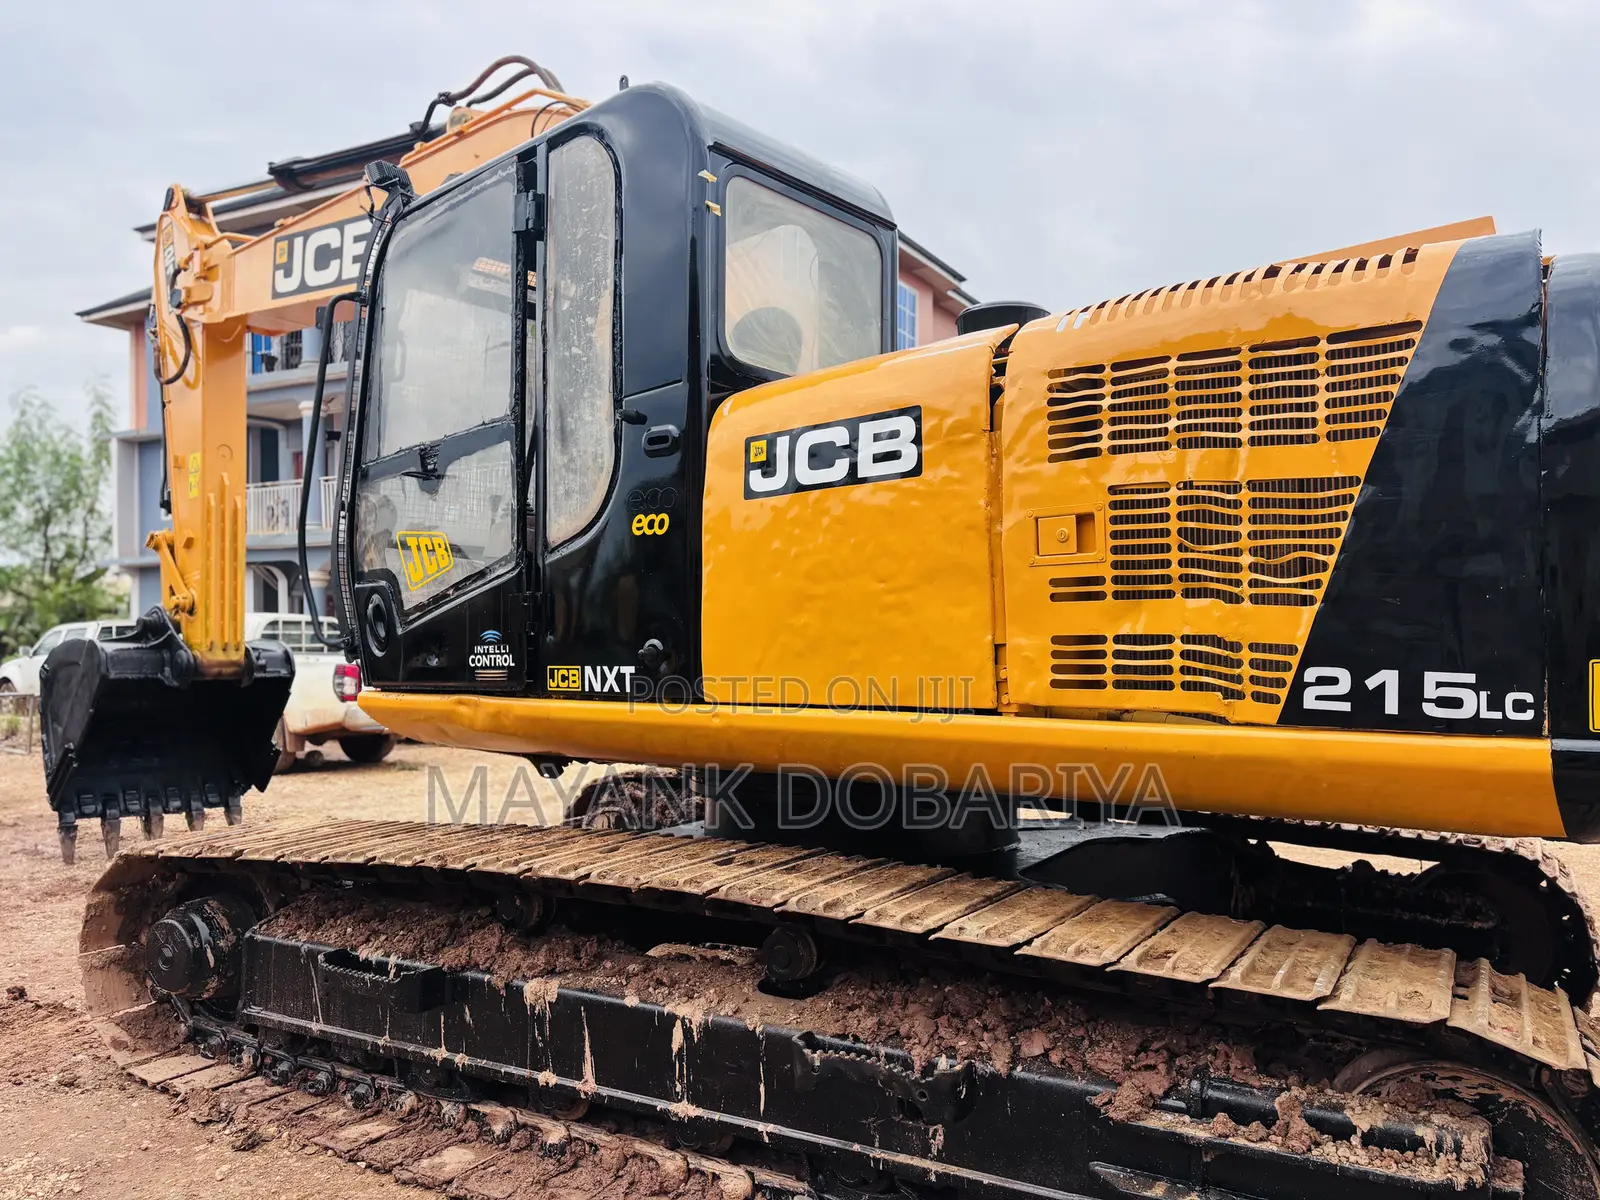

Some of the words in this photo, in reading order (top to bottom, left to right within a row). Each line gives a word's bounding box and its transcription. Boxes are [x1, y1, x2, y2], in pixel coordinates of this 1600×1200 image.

[749, 415, 918, 492] JCB
[632, 512, 670, 536] eco
[405, 536, 450, 584] JCB
[469, 654, 515, 667] CONTROL
[474, 645, 509, 654] INTELLI
[549, 668, 581, 688] JCB
[584, 665, 636, 692] NXT
